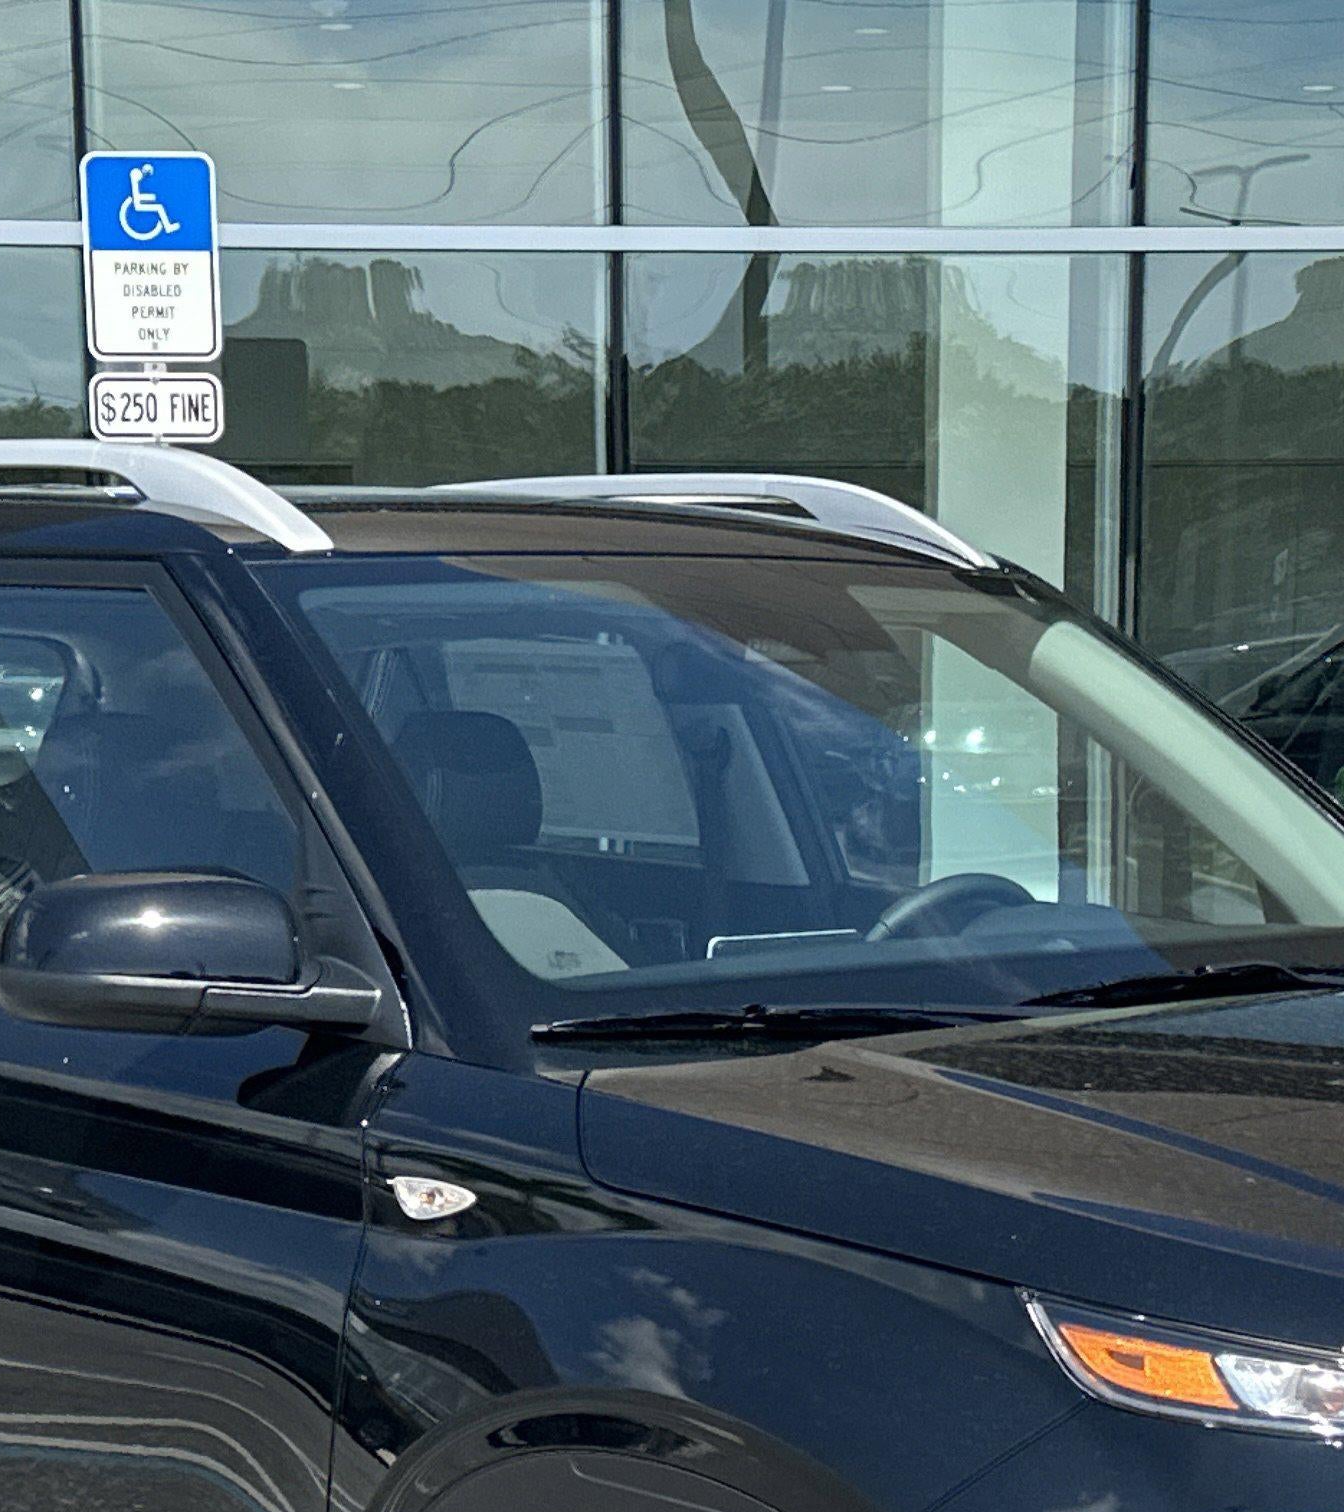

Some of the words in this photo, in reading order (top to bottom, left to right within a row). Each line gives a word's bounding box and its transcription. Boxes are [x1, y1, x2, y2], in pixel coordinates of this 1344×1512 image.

[114, 262, 167, 275] PARKING
[173, 262, 189, 275] BY
[123, 284, 182, 297] DISABLED
[131, 305, 175, 319] PERMIT
[138, 327, 171, 340] ONLY
[101, 392, 157, 426] $250
[170, 393, 212, 422] FINE
